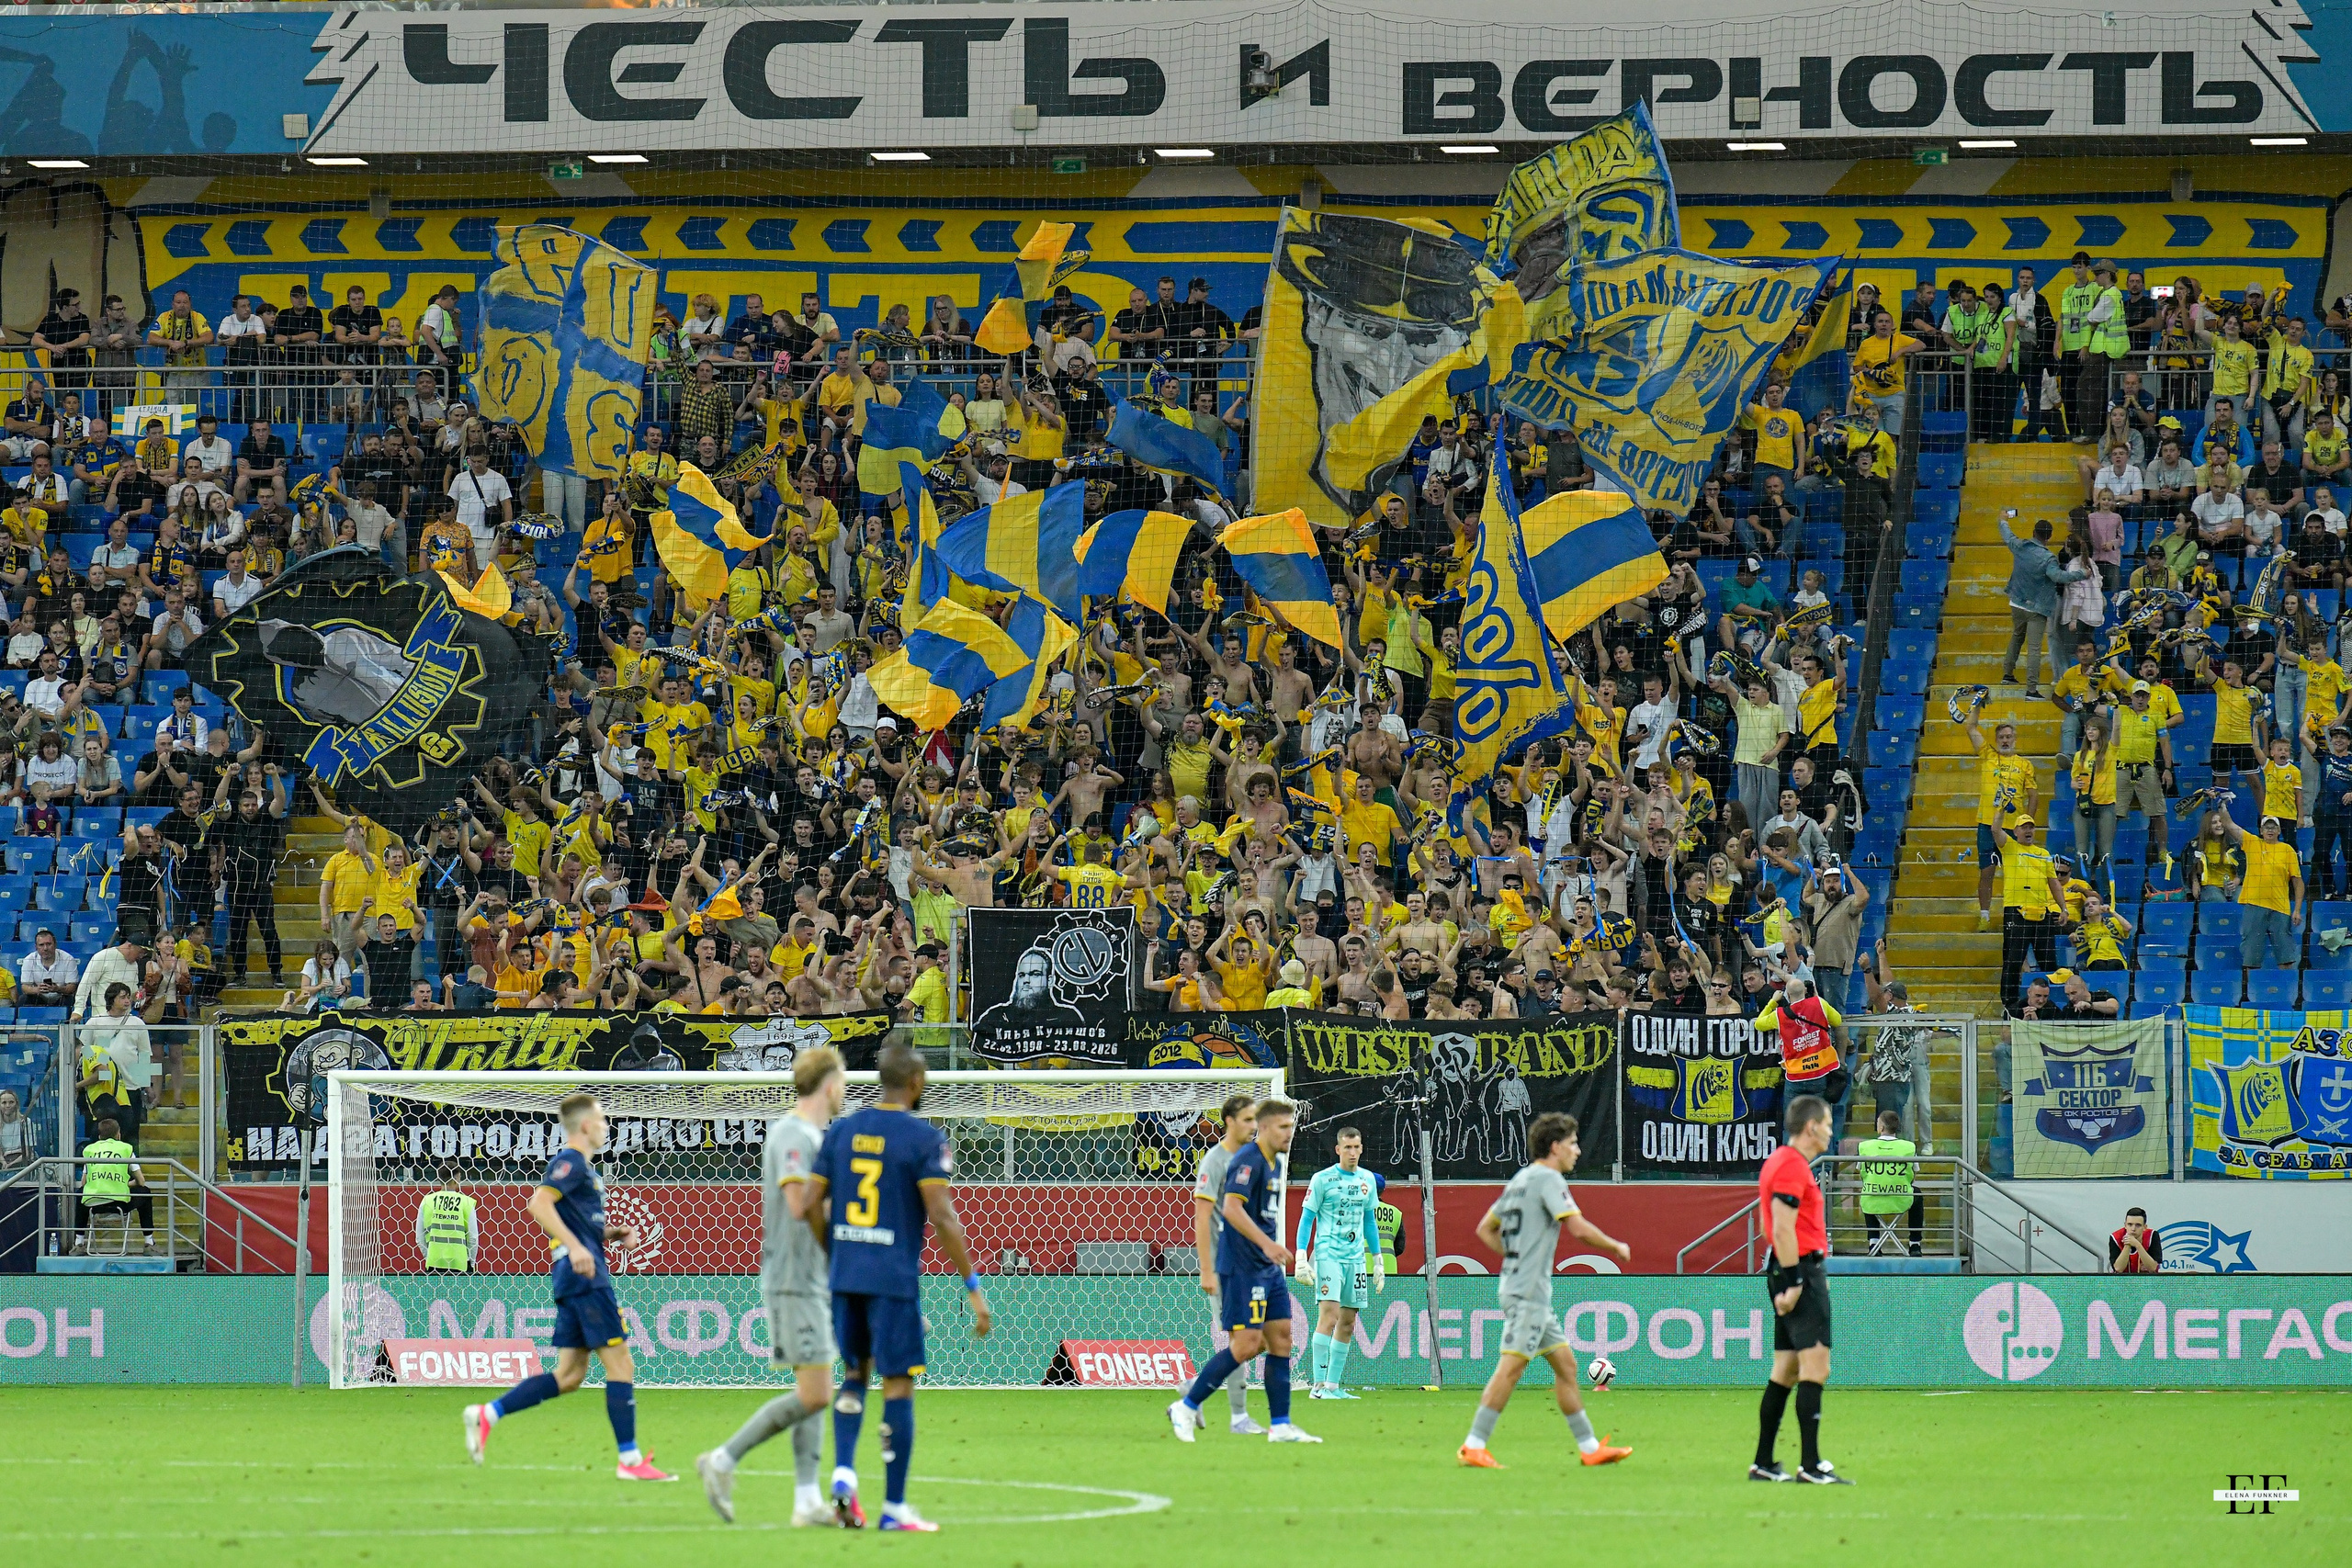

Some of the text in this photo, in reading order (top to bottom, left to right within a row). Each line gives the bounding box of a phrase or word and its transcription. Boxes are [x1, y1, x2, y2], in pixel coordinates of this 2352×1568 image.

[403, 18, 2263, 135] ЧЕСТЬ И ВЕРНОСТЬ
[1969, 462, 1981, 470] 23
[1077, 885, 1105, 908] 88
[1075, 919, 1113, 935] LADS
[2094, 938, 2102, 949] 7
[388, 1011, 589, 1070] Unity
[766, 1032, 795, 1041] 1698
[1632, 1014, 1782, 1057] ОДИН ГОРОД
[1792, 1030, 1821, 1045] FONBET
[1154, 1046, 1182, 1059] 2012
[1298, 1027, 1432, 1074] WEST
[1476, 1026, 1616, 1075] BAND
[1802, 1063, 1819, 1071] 1414
[2058, 1089, 2122, 1109] СЕКТОР
[2080, 1109, 2120, 1117] РОСТОВ
[247, 1126, 301, 1161] НА
[1642, 1120, 1777, 1164] ОДИН КЛУБ
[2219, 1145, 2248, 1168] ЗА
[845, 1157, 884, 1227] 3
[1862, 1183, 1909, 1195] STEWARD
[433, 1195, 461, 1212] 17862
[432, 1213, 459, 1221] STEWARD
[1354, 1272, 1367, 1290] 39
[1249, 1300, 1268, 1325] 17
[0, 1306, 104, 1358] ОН
[1351, 1299, 1763, 1359] МЕГФОН
[399, 1350, 530, 1381] FONBET
[1078, 1353, 1188, 1383] FONBET
